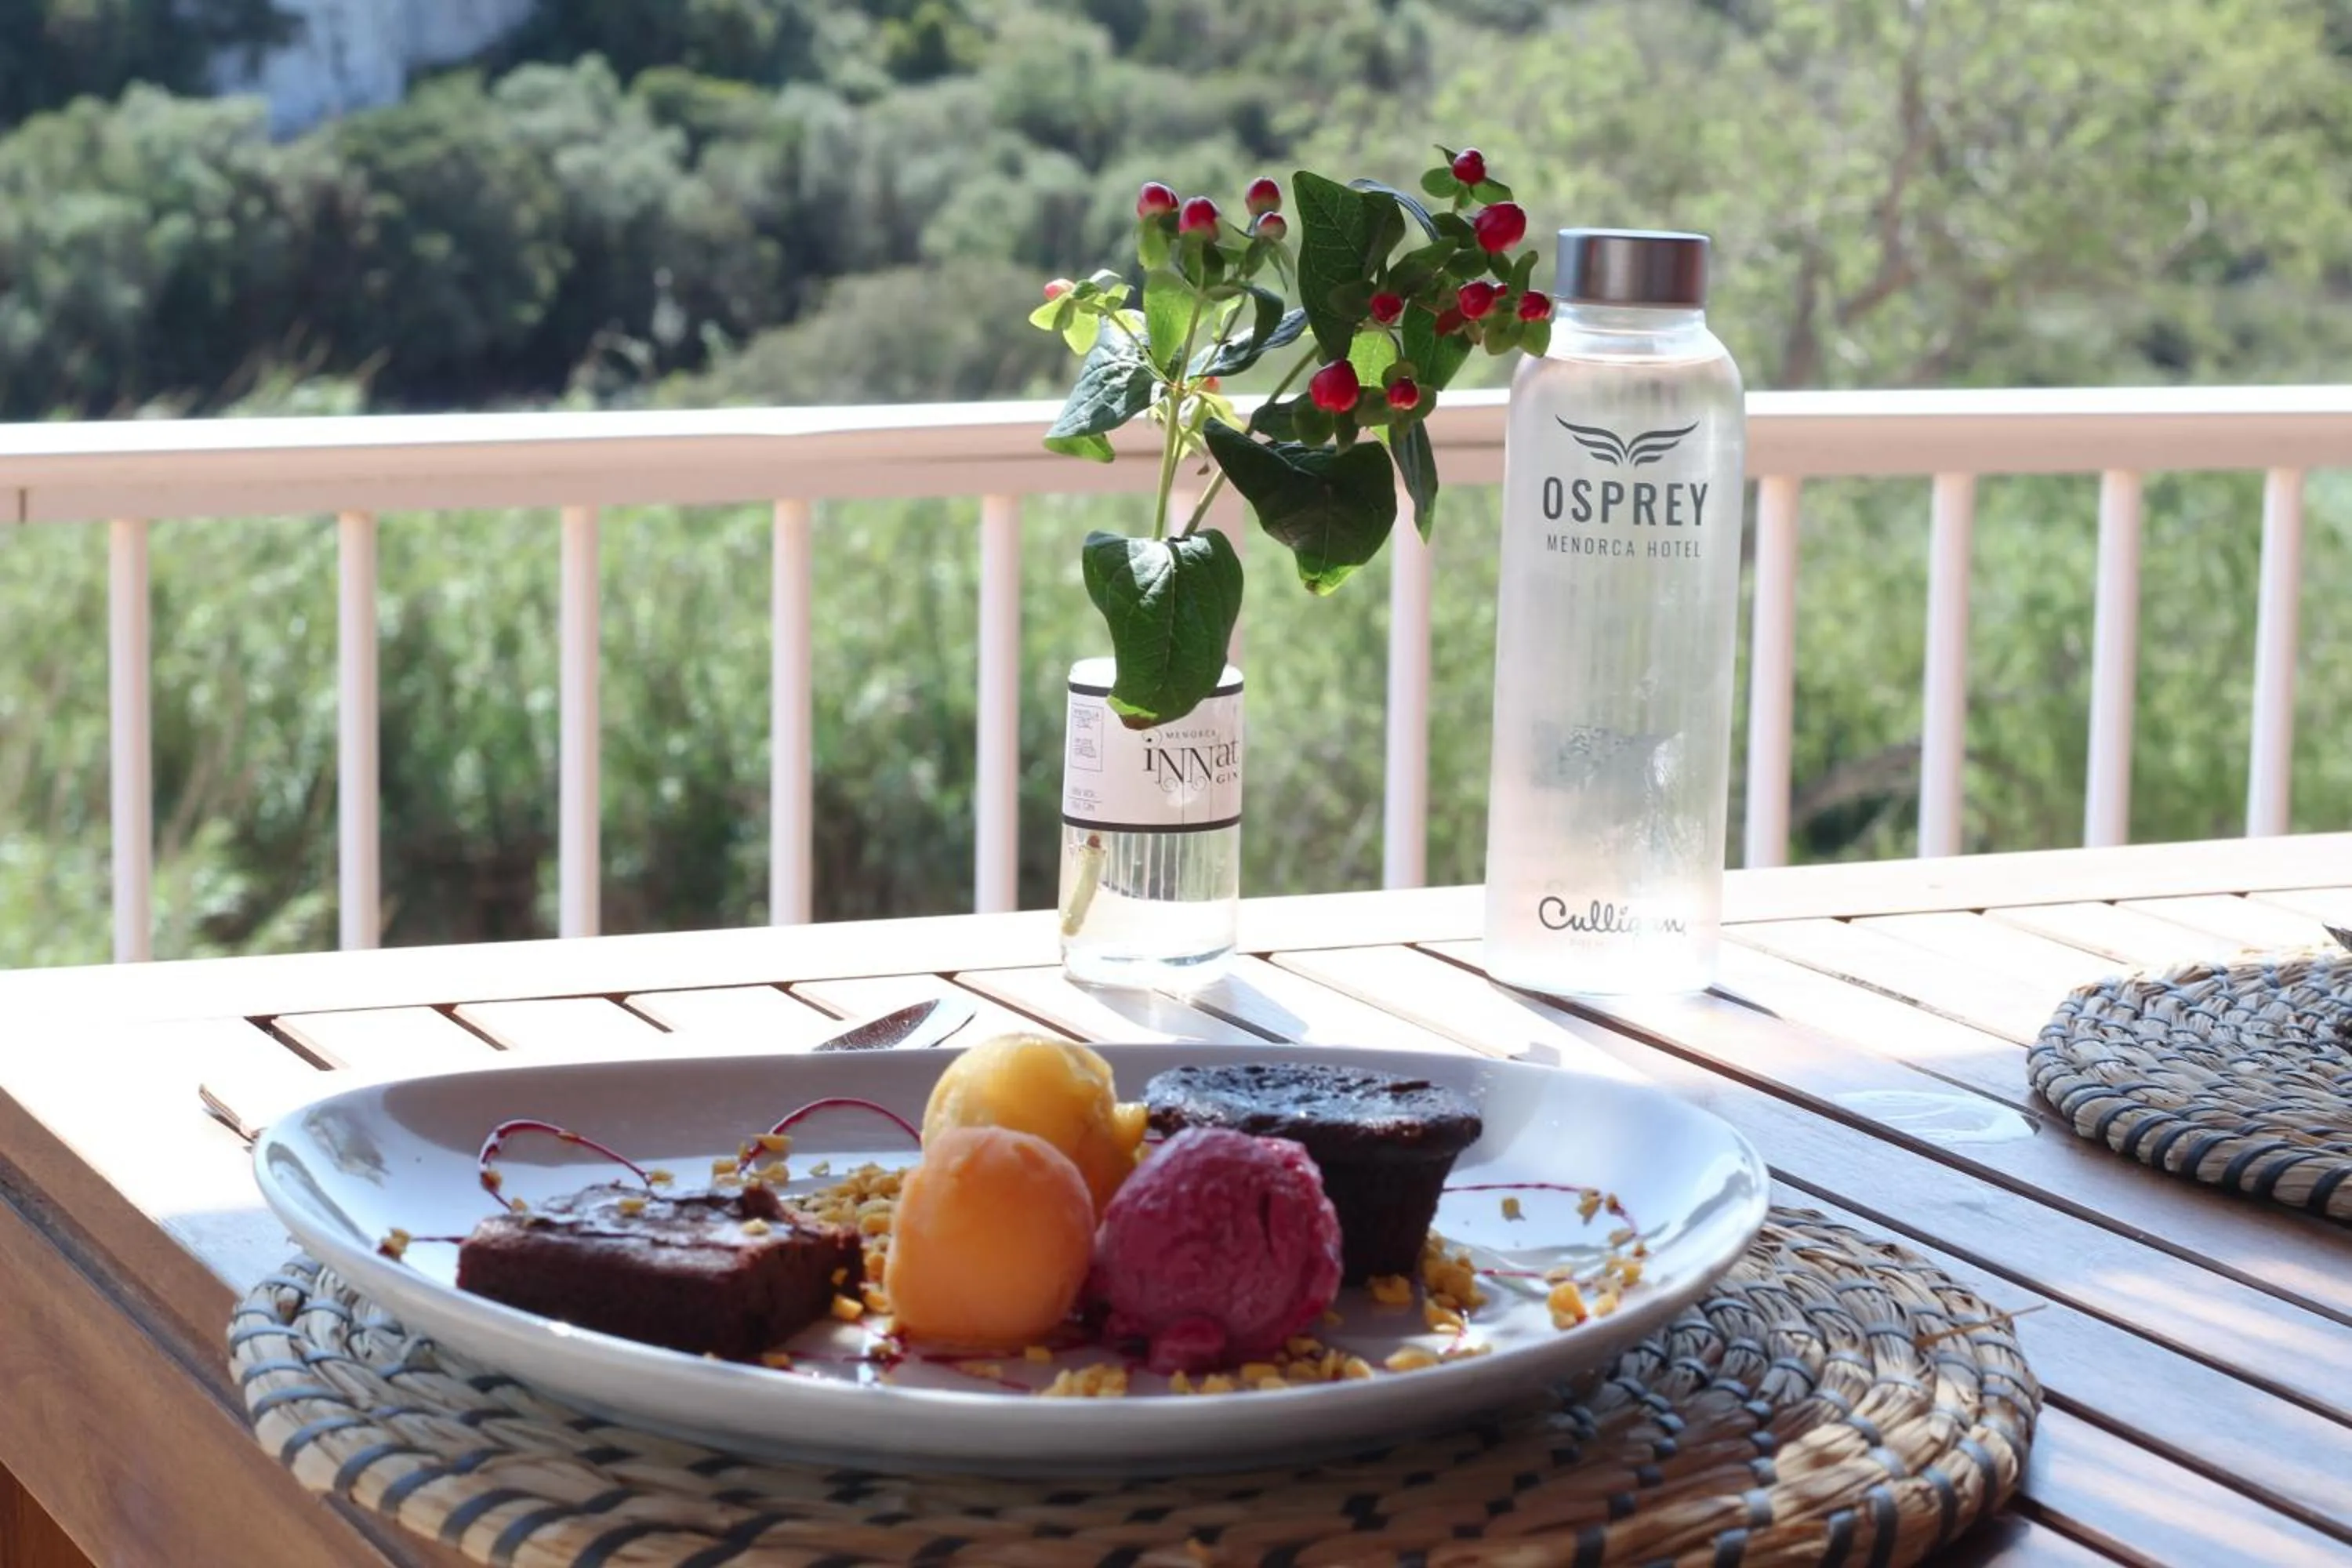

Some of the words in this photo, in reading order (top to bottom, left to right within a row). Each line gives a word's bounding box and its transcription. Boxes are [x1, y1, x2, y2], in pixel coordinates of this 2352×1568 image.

[1543, 476, 1708, 526] OSPREY
[1547, 533, 1635, 557] MENORCA
[1647, 540, 1701, 558] HOTEL
[1538, 896, 1686, 935] Cullign
